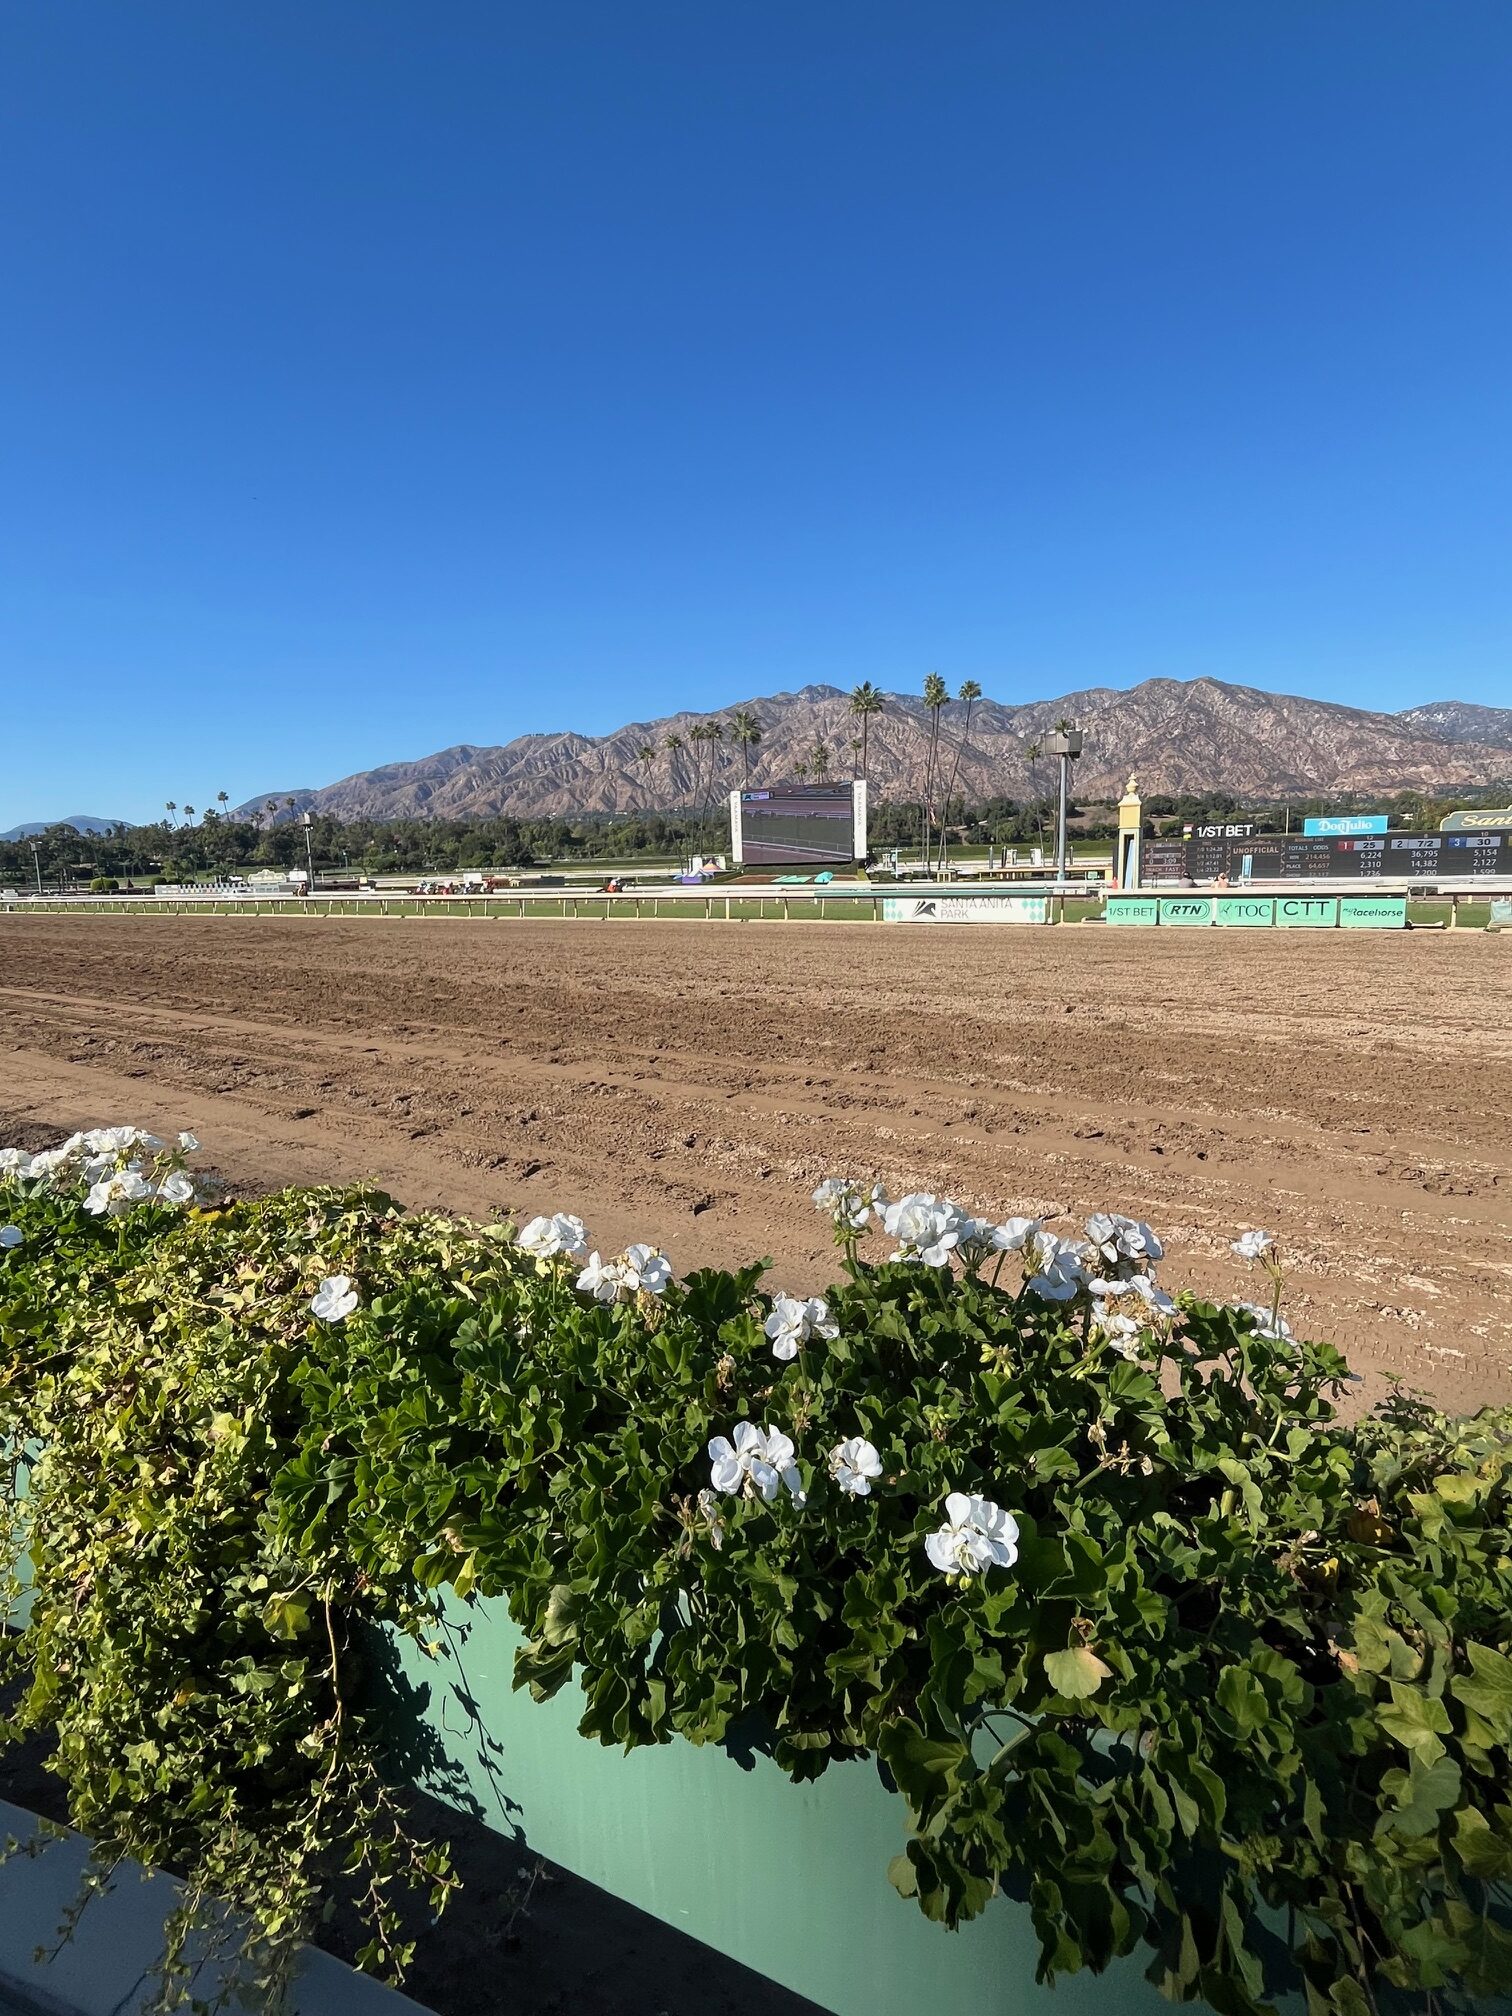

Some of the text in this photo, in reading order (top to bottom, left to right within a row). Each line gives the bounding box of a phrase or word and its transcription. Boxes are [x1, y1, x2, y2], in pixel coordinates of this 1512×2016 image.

[1197, 824, 1253, 838] 1/ST BET
[1319, 820, 1373, 834] Don Julio
[1344, 842, 1348, 850] 1
[1418, 840, 1434, 848] 7/2
[1454, 838, 1460, 847] 3
[1233, 846, 1279, 855] UNOFFICIAL
[1360, 851, 1382, 859] 6,224
[1411, 850, 1438, 858] 36,795
[1474, 849, 1498, 857] 5,154
[1360, 861, 1382, 869] 2,310
[1411, 860, 1438, 868] 14,382
[1473, 859, 1497, 867] 2,127
[941, 898, 1013, 909] SANTA ANITA
[1109, 907, 1154, 917] 1/ST BET
[1170, 905, 1202, 915] RTN
[1235, 905, 1270, 918] TOC
[1283, 901, 1330, 916] CTT
[941, 910, 969, 919] PARK
